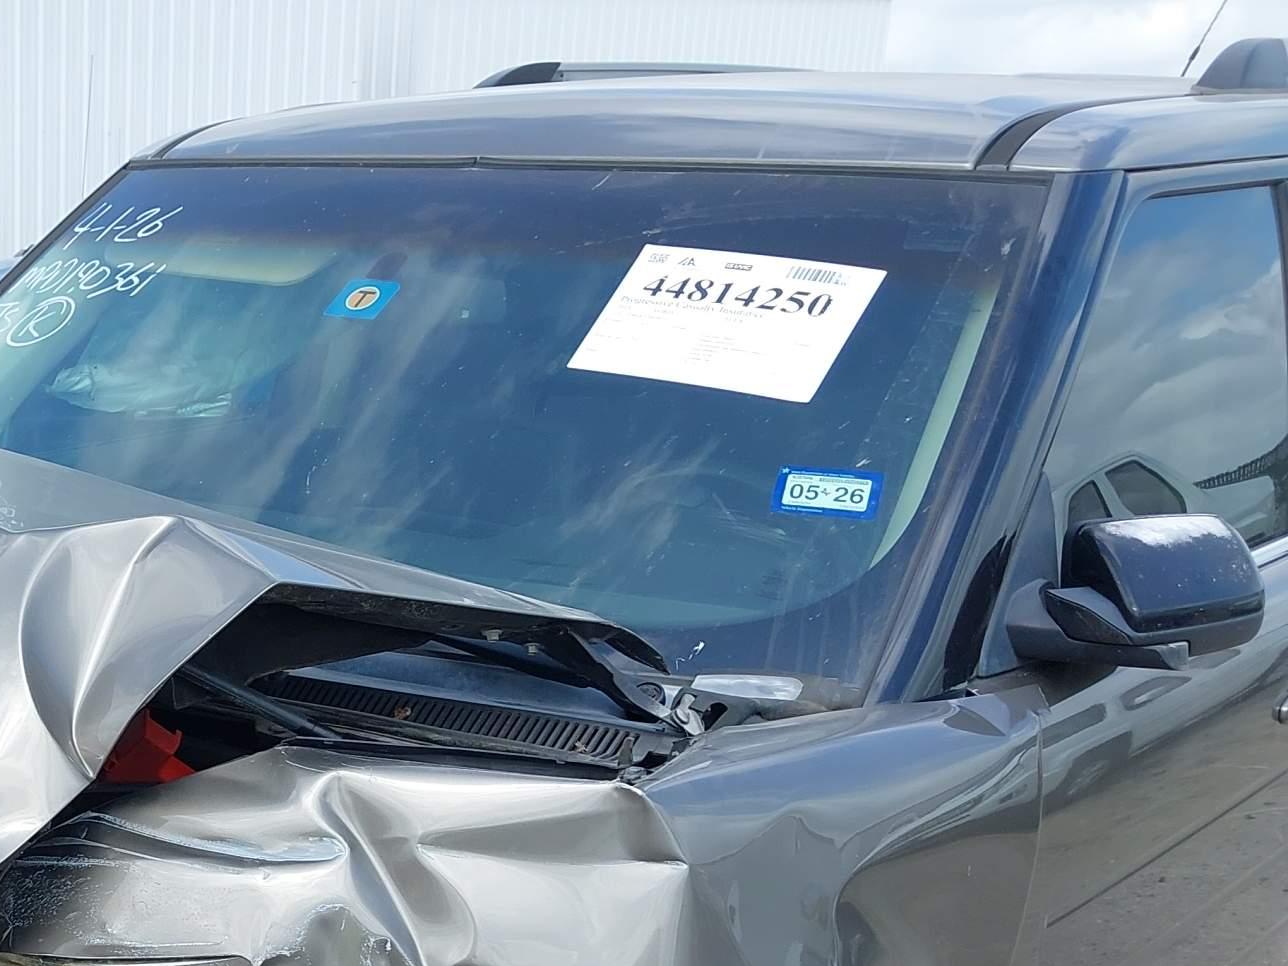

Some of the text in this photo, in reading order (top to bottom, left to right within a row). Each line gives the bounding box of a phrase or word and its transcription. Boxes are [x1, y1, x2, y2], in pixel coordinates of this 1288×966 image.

[63, 202, 183, 250] 4-1-26
[643, 274, 834, 318] 44814250
[789, 483, 865, 504] 05 26
